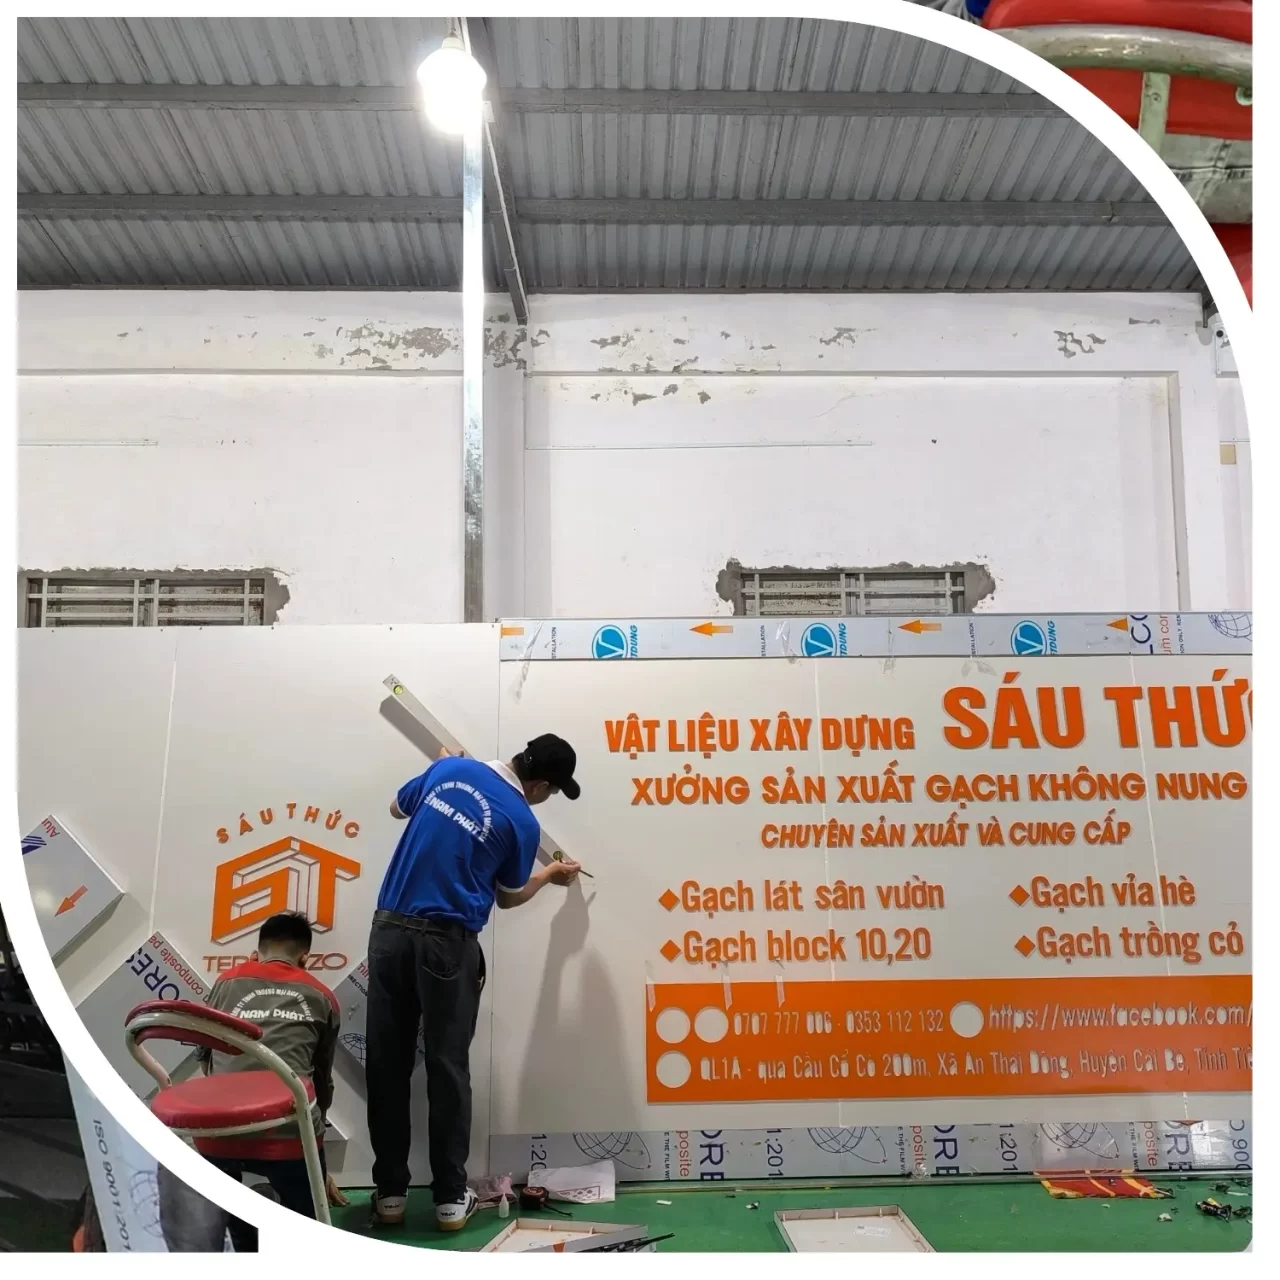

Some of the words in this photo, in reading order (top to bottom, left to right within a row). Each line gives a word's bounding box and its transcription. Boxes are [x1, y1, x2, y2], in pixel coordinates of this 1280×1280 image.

[604, 712, 660, 760] VẬT
[668, 711, 739, 759] LIỆU
[750, 710, 812, 752] XÂY
[821, 714, 915, 757] DỰNG
[942, 671, 1086, 750] SÁU
[1103, 668, 1252, 749] THỨ
[630, 763, 751, 806] XƯỞNG
[761, 766, 827, 804] SẢN
[836, 759, 915, 804] XUẤT
[925, 773, 1020, 809] GẠCH
[1028, 765, 1146, 802] KHÔNG
[1156, 771, 1248, 800] NUNG
[216, 808, 273, 844] SÁU
[286, 802, 360, 838] THỨC
[428, 796, 455, 817] NAM
[452, 812, 481, 835] PHÁT
[760, 817, 855, 848] CHUYÊN
[860, 815, 906, 847] SẢN
[911, 811, 970, 847] XUẤT
[977, 816, 1005, 847] VÀ
[1009, 821, 1076, 846] CUNG
[1083, 807, 1131, 846] CẤP
[681, 879, 754, 920] Gạch
[764, 879, 804, 912] lát
[814, 879, 866, 911] sân
[876, 874, 945, 910] vườn
[1031, 875, 1105, 914] Gạch
[1111, 872, 1155, 907] vỉa
[1160, 875, 1196, 907] hè
[683, 930, 757, 969] Gạch
[767, 929, 847, 962] block
[855, 927, 932, 965] 10,20
[1037, 926, 1112, 964] Gạch
[1120, 920, 1202, 964] trồng
[1208, 921, 1244, 956] cỏ
[161, 946, 204, 996] composite
[239, 1009, 270, 1019] NAM
[273, 1008, 305, 1021] PHÁT
[733, 1011, 769, 1036] 0707
[773, 1012, 800, 1035] 777
[846, 1010, 882, 1034] 0353
[887, 1010, 912, 1033] 112
[918, 1009, 944, 1033] 132
[758, 1060, 786, 1084] qua
[965, 1051, 984, 1075] An
[93, 1119, 109, 1155] ISO
